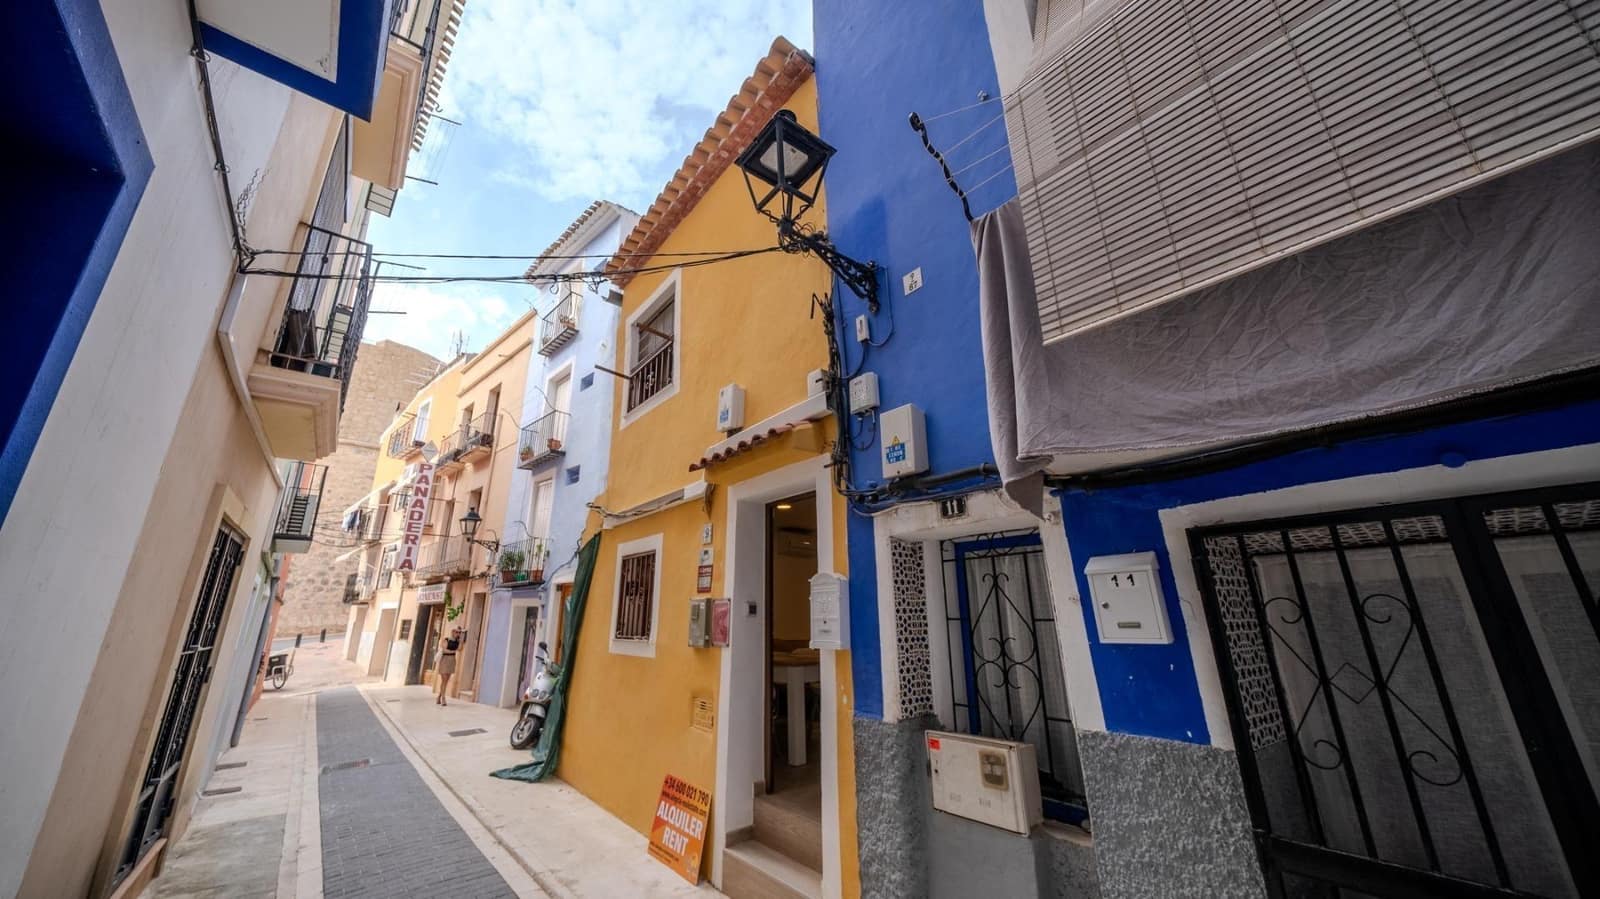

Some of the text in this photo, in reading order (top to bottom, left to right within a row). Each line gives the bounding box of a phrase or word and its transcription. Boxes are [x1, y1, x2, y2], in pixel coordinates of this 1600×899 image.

[399, 463, 432, 569] PANADERIA
[946, 499, 959, 515] 11
[657, 800, 703, 840] ALQUILER
[662, 826, 688, 856] RENT
